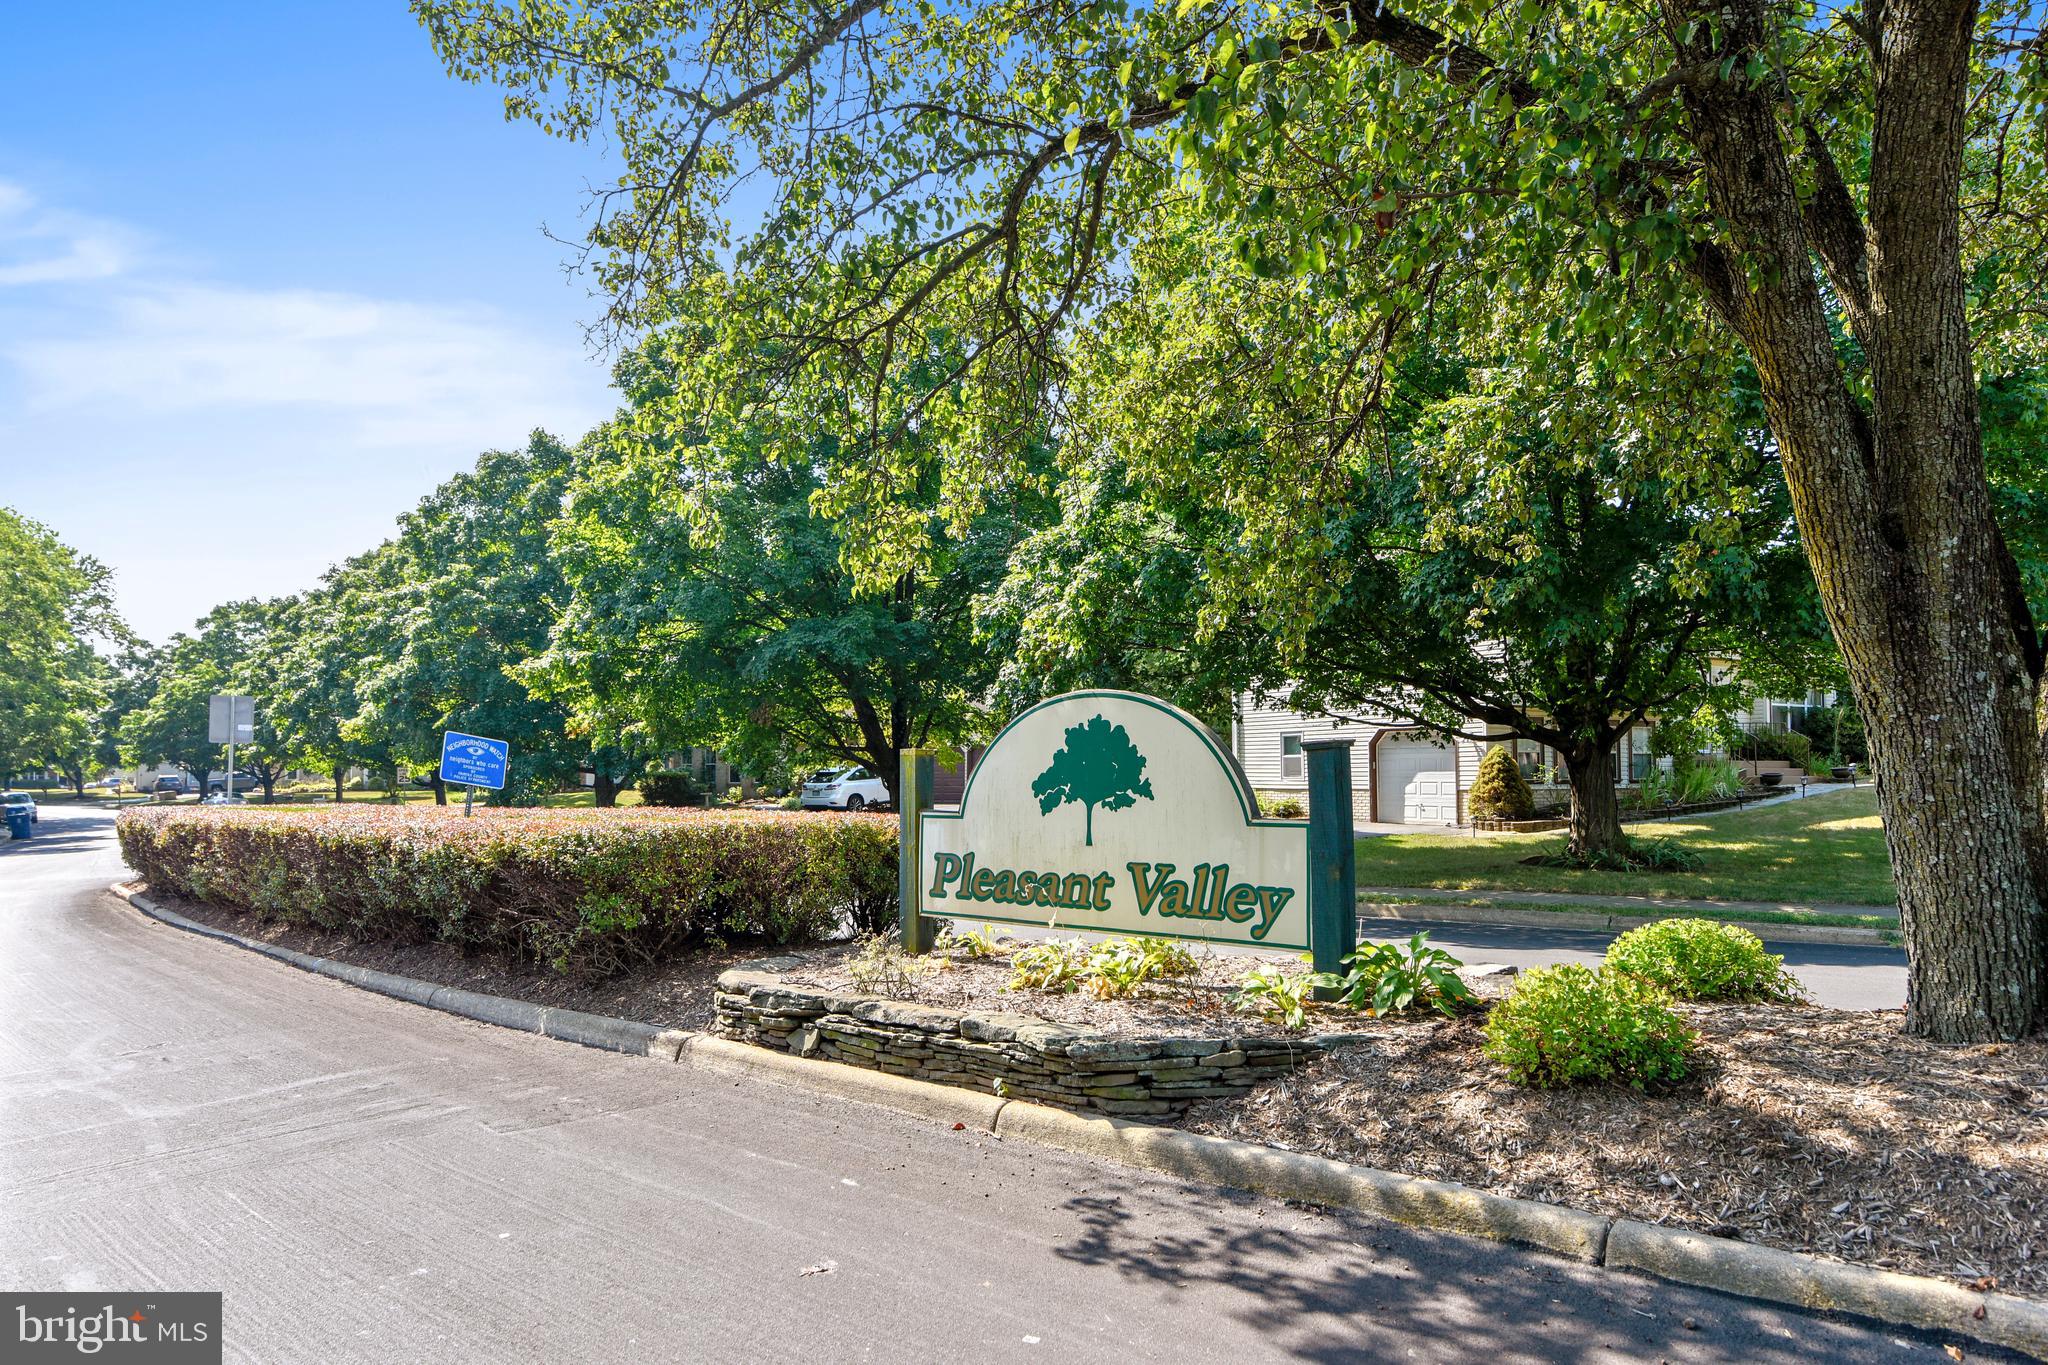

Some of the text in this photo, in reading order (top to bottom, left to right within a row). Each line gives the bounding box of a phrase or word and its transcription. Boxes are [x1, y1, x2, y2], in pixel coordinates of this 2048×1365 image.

[447, 739, 505, 761] NEIGHBORHOOD WATCH
[929, 851, 1294, 940] Pleasant Valley
